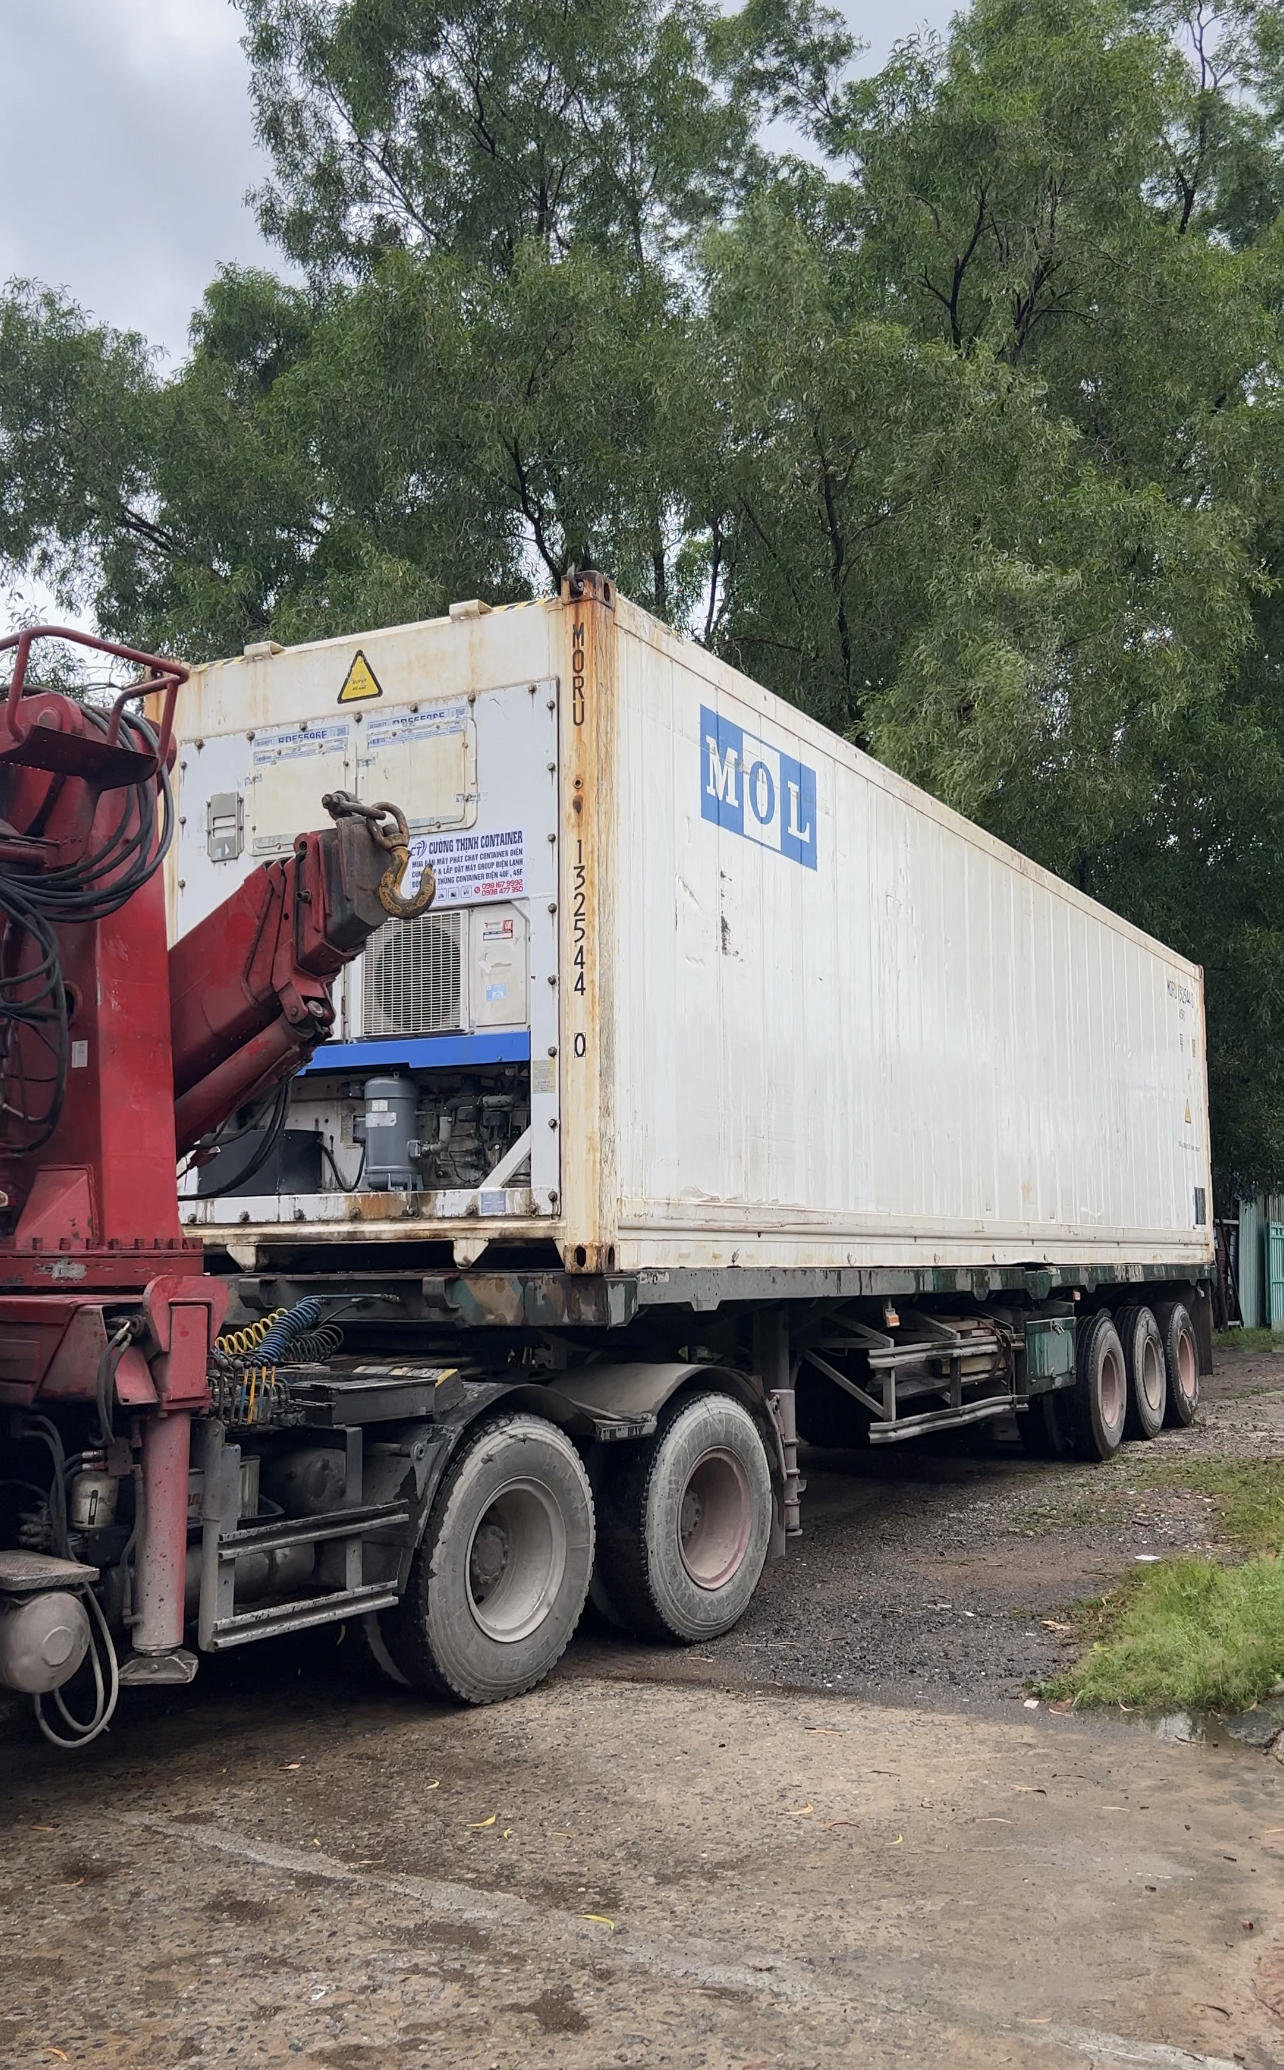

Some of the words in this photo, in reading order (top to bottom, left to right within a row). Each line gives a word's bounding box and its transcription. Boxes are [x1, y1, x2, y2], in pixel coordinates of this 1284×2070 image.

[572, 622, 585, 727] MORU
[706, 734, 810, 844] MOL
[428, 838, 454, 855] CƯỜNG
[456, 836, 479, 853] THỊNH
[480, 831, 523, 849] CONTAINER
[479, 850, 509, 861] CONTAINER
[455, 873, 485, 884] CONTAINER
[513, 868, 523, 876] 45F
[477, 861, 495, 871] GROUP
[481, 881, 495, 890] 098
[495, 880, 505, 889] 167
[506, 878, 523, 888] 9992
[498, 886, 510, 895] 477
[573, 839, 586, 997] 132544
[574, 1032, 586, 1058] 0
